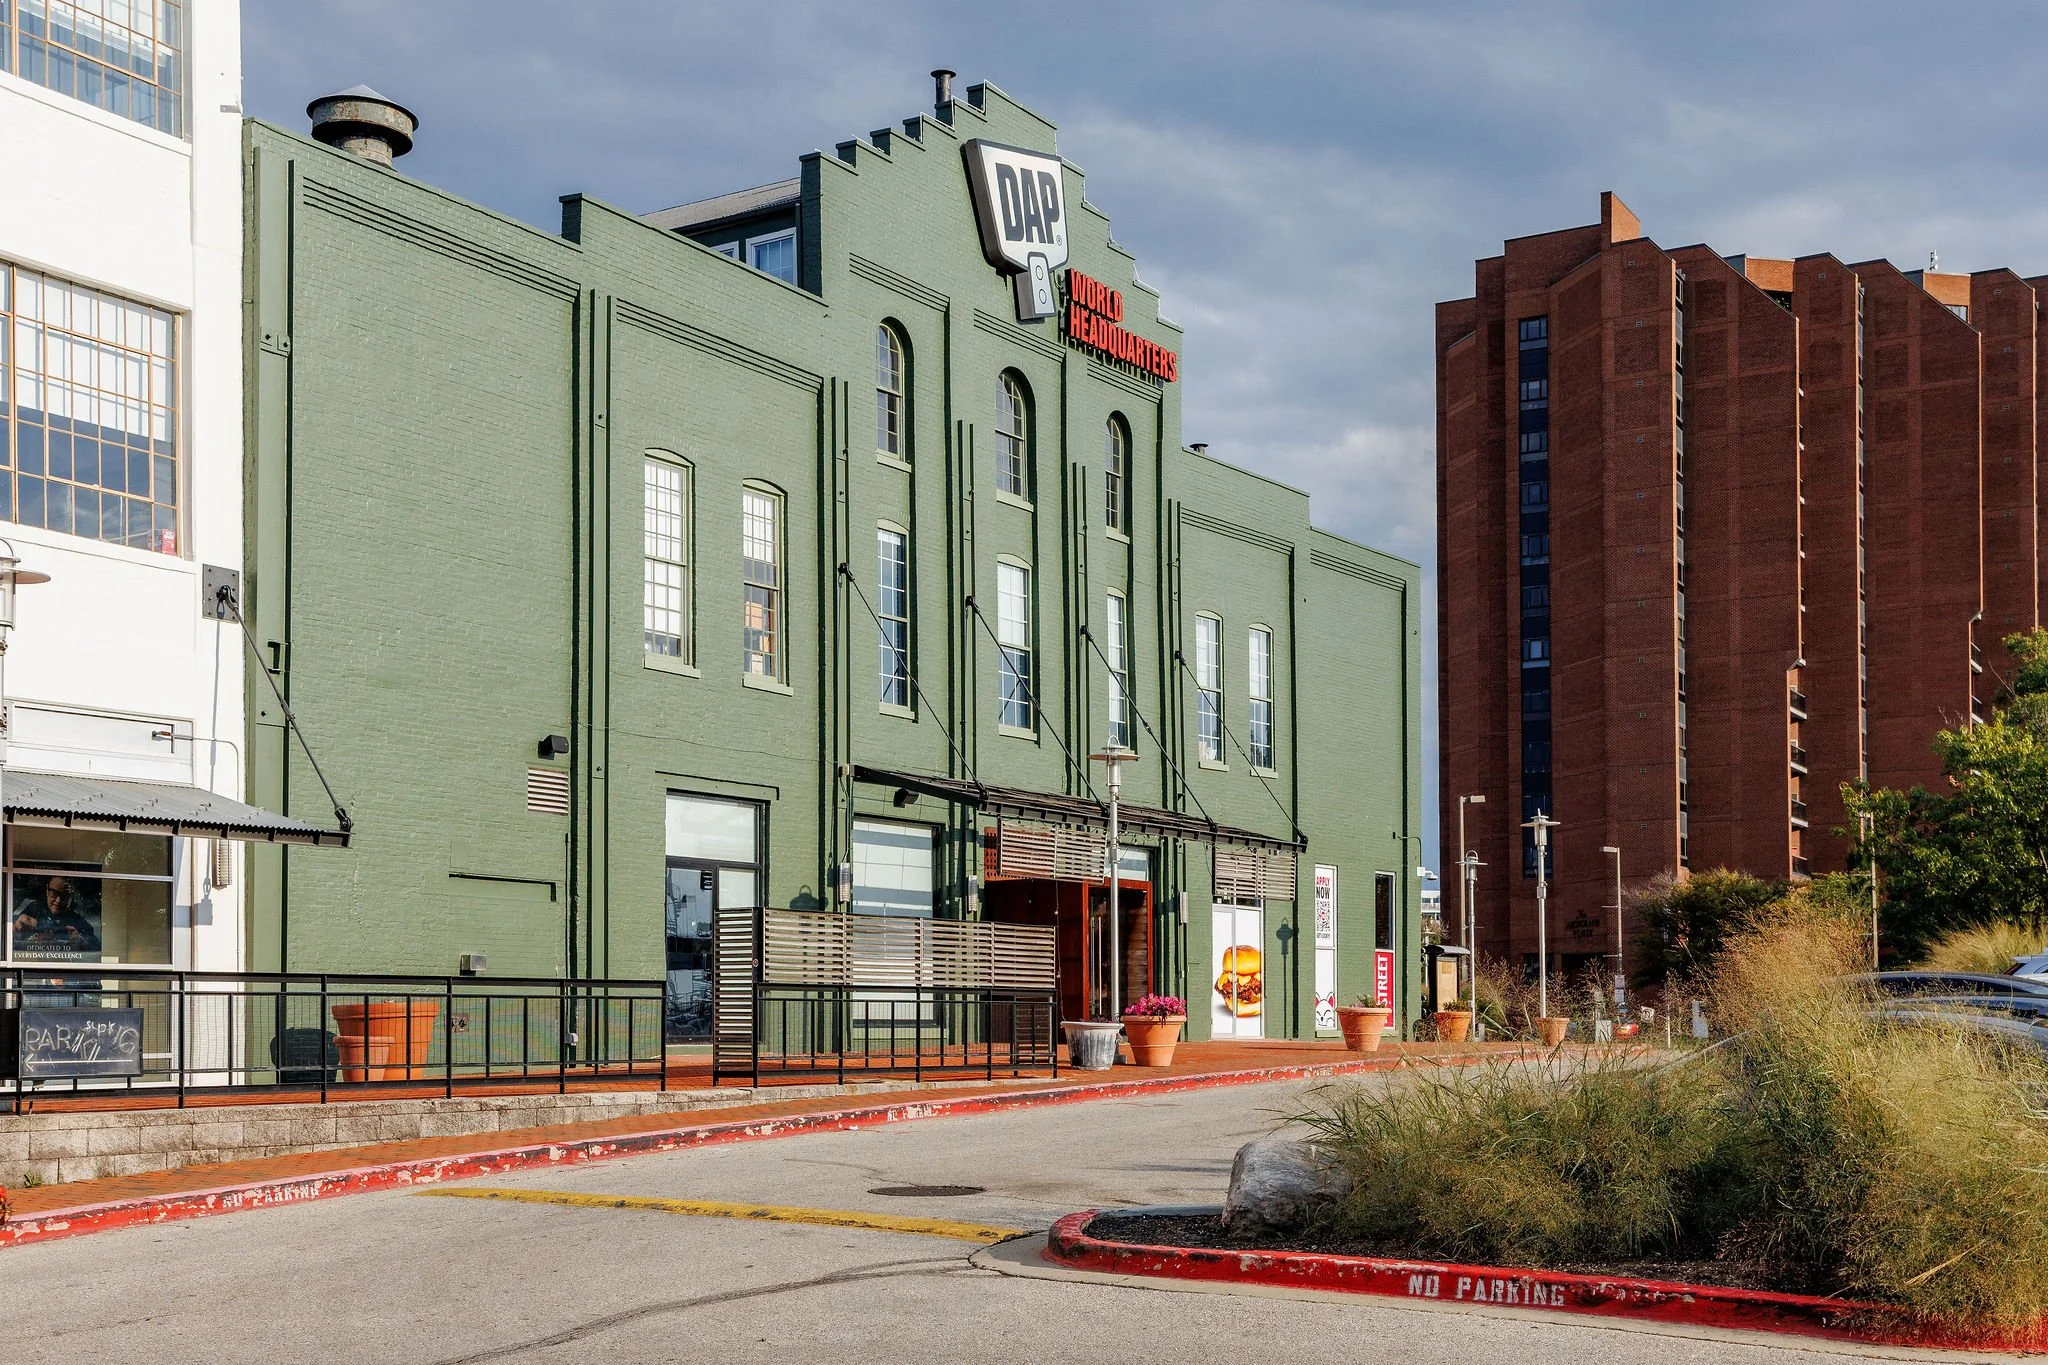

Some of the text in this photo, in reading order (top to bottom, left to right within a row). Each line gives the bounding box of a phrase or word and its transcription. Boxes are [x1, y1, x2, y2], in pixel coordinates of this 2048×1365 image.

[995, 162, 1061, 245] DAP
[1069, 268, 1123, 322] WORLD
[1069, 303, 1178, 383] HEADQUARTERS
[1316, 876, 1330, 887] APPLY
[1316, 886, 1331, 900] NOW
[1377, 954, 1389, 1006] STREET
[1408, 1274, 1565, 1307] NO PARKING
